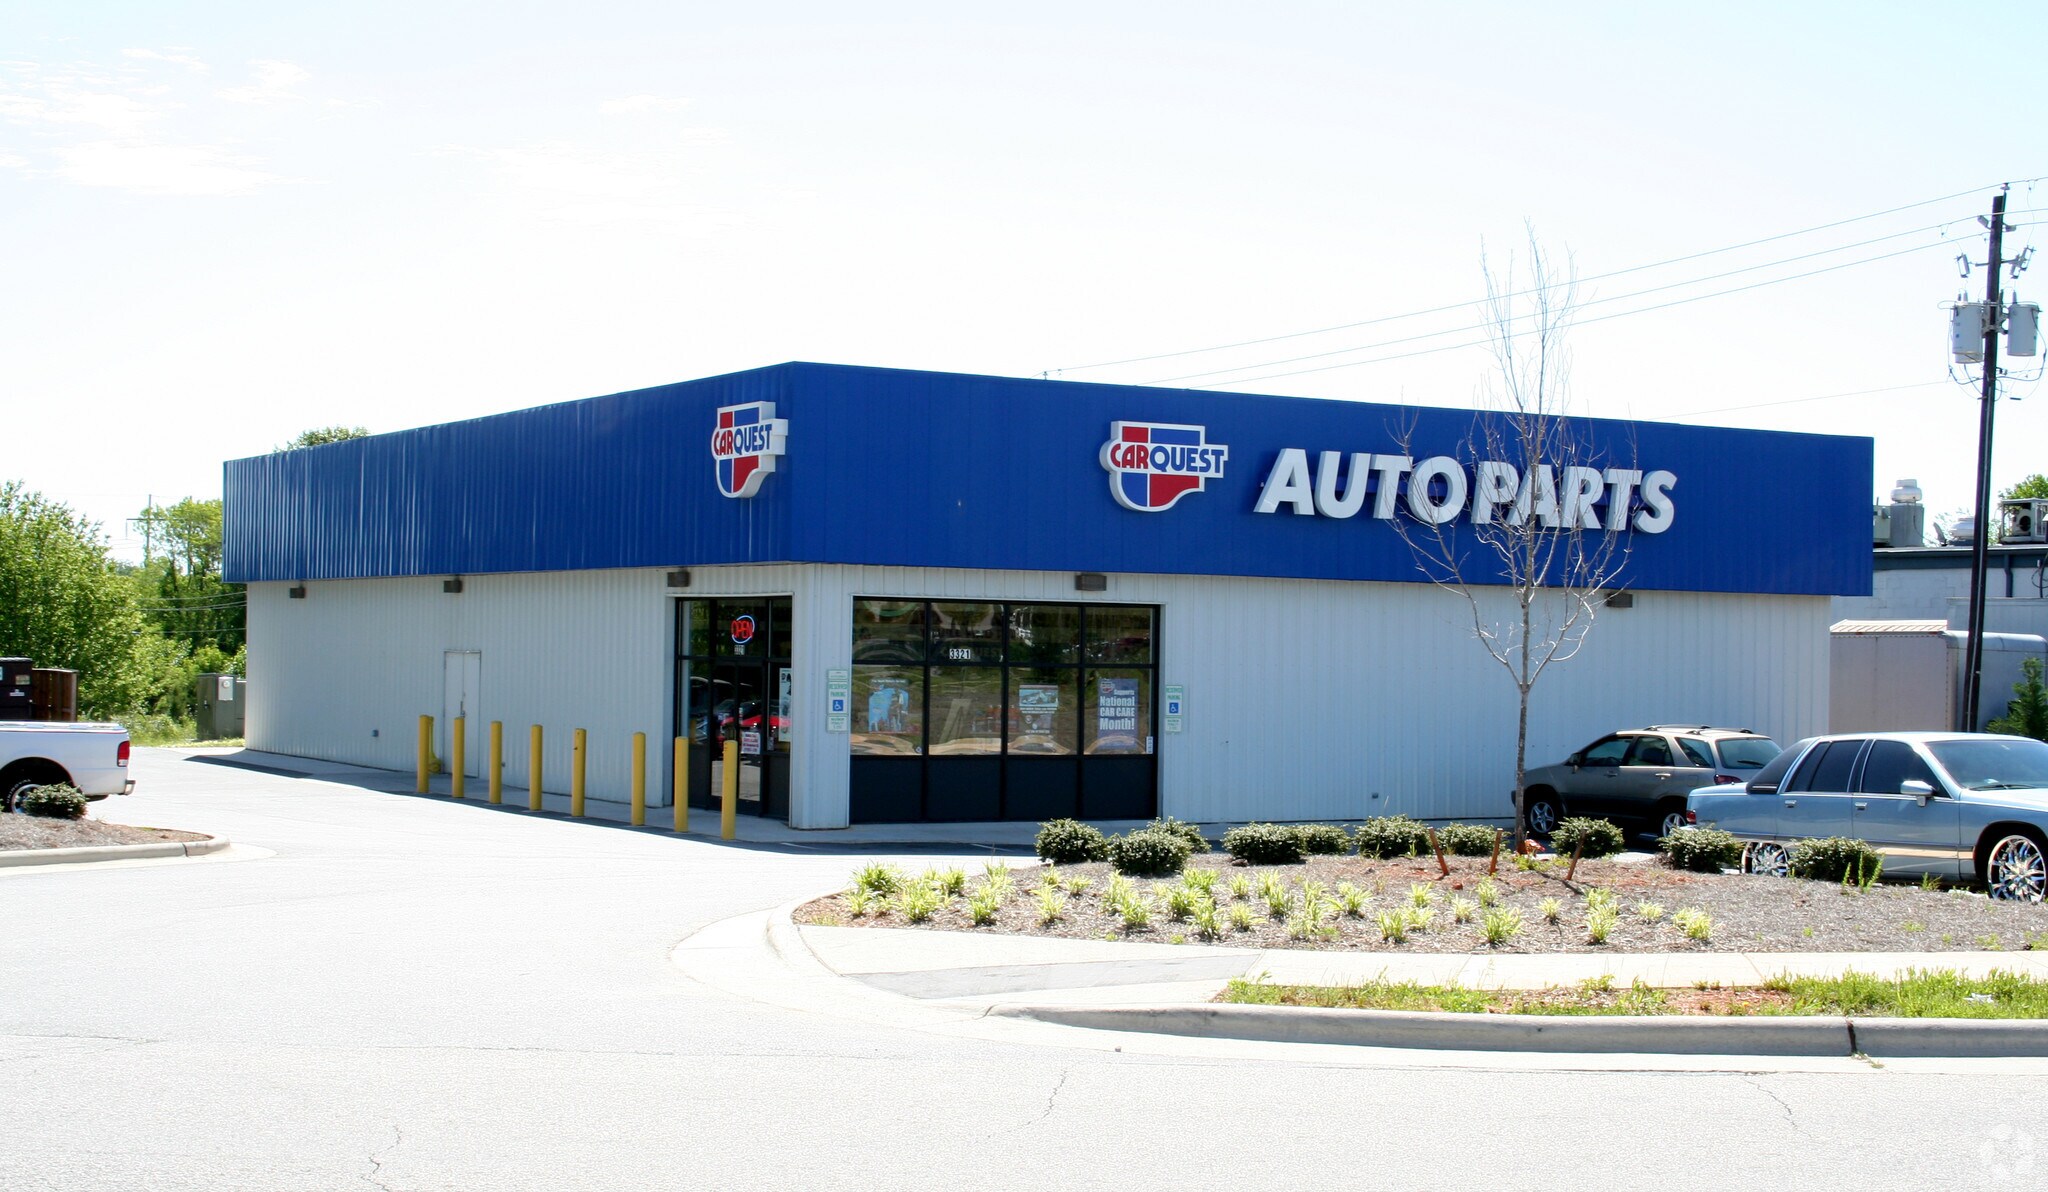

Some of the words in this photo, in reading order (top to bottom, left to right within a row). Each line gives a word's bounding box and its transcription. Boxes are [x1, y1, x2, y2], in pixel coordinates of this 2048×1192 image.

[713, 423, 773, 456] CARQUEST
[1110, 443, 1225, 474] CARQUEST
[1253, 447, 1468, 525] AUTO
[1470, 460, 1678, 535] PARTS
[731, 620, 753, 639] OPEN
[950, 649, 970, 660] 3321
[1100, 696, 1135, 706] National
[1100, 707, 1115, 717] CAR
[1116, 707, 1135, 717] CARE
[1100, 718, 1135, 730] Month!
